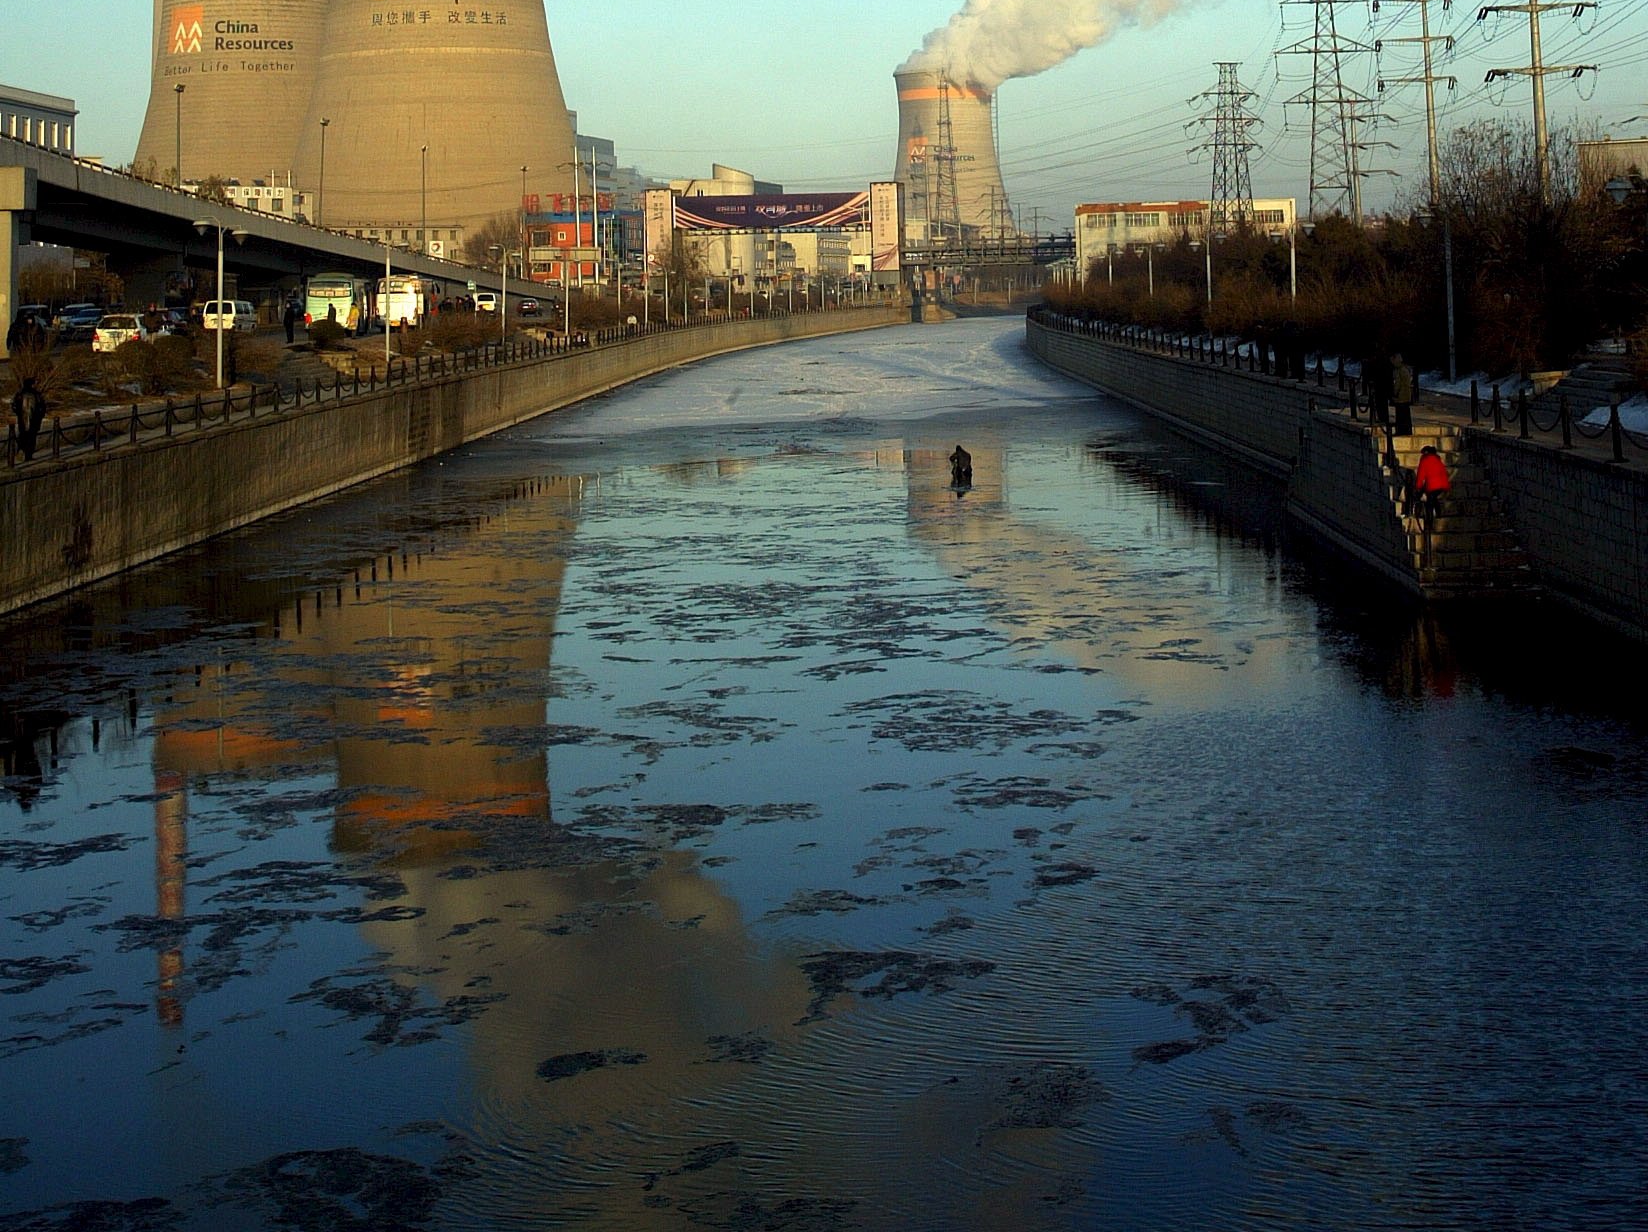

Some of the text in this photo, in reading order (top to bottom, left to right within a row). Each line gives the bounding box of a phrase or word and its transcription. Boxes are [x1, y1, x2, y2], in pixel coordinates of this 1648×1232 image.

[214, 20, 259, 34] China
[214, 37, 294, 51] Resources
[201, 61, 229, 73] Life
[240, 60, 295, 73] Together
